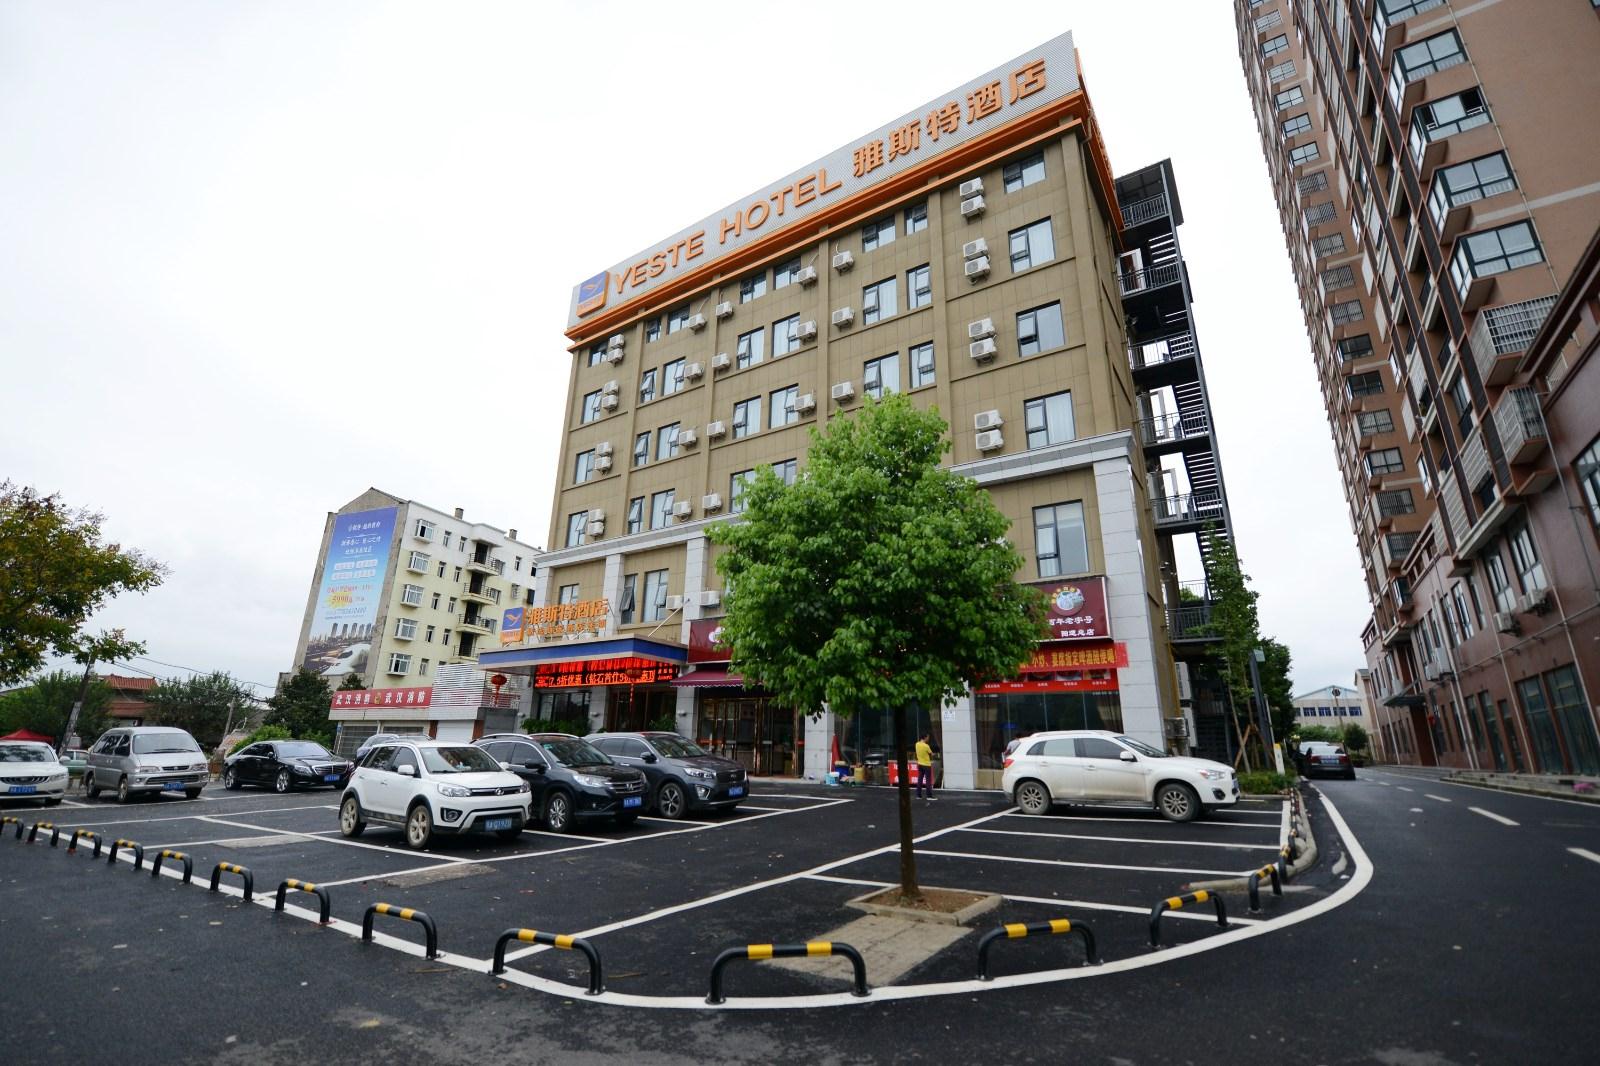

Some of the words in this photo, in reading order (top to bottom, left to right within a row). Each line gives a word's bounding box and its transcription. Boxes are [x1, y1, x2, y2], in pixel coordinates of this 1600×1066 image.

[852, 58, 1046, 178] 雅斯特酒店
[614, 231, 705, 294] YESTE
[719, 168, 842, 244] HOTEL
[528, 599, 608, 625] 雅斯特酒店
